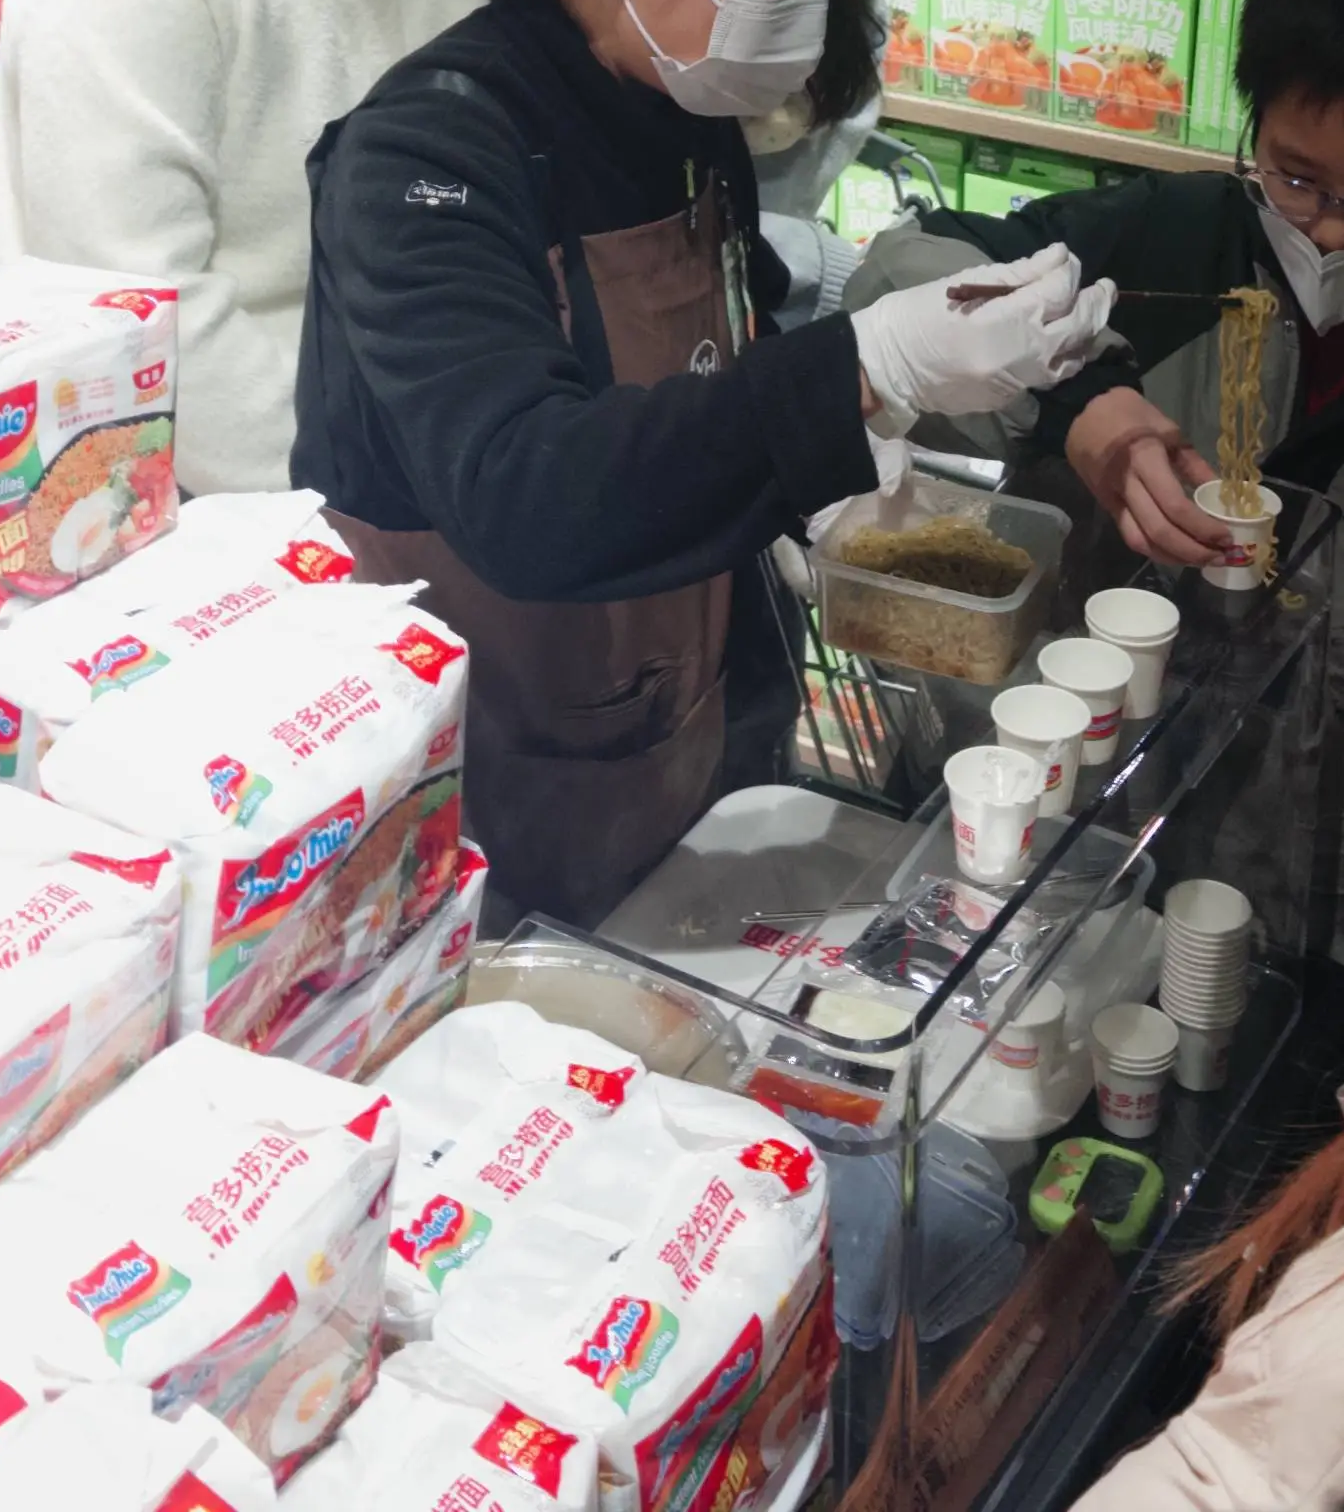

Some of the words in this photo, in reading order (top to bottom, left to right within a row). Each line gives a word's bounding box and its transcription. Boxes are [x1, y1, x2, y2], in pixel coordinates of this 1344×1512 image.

[1068, 17, 1178, 58] 风味汤底
[269, 675, 374, 747] 营多捞面
[182, 1134, 295, 1234] 营多捞面
[477, 1106, 561, 1189] 营多捞面
[659, 1176, 734, 1277] 营多捞面
